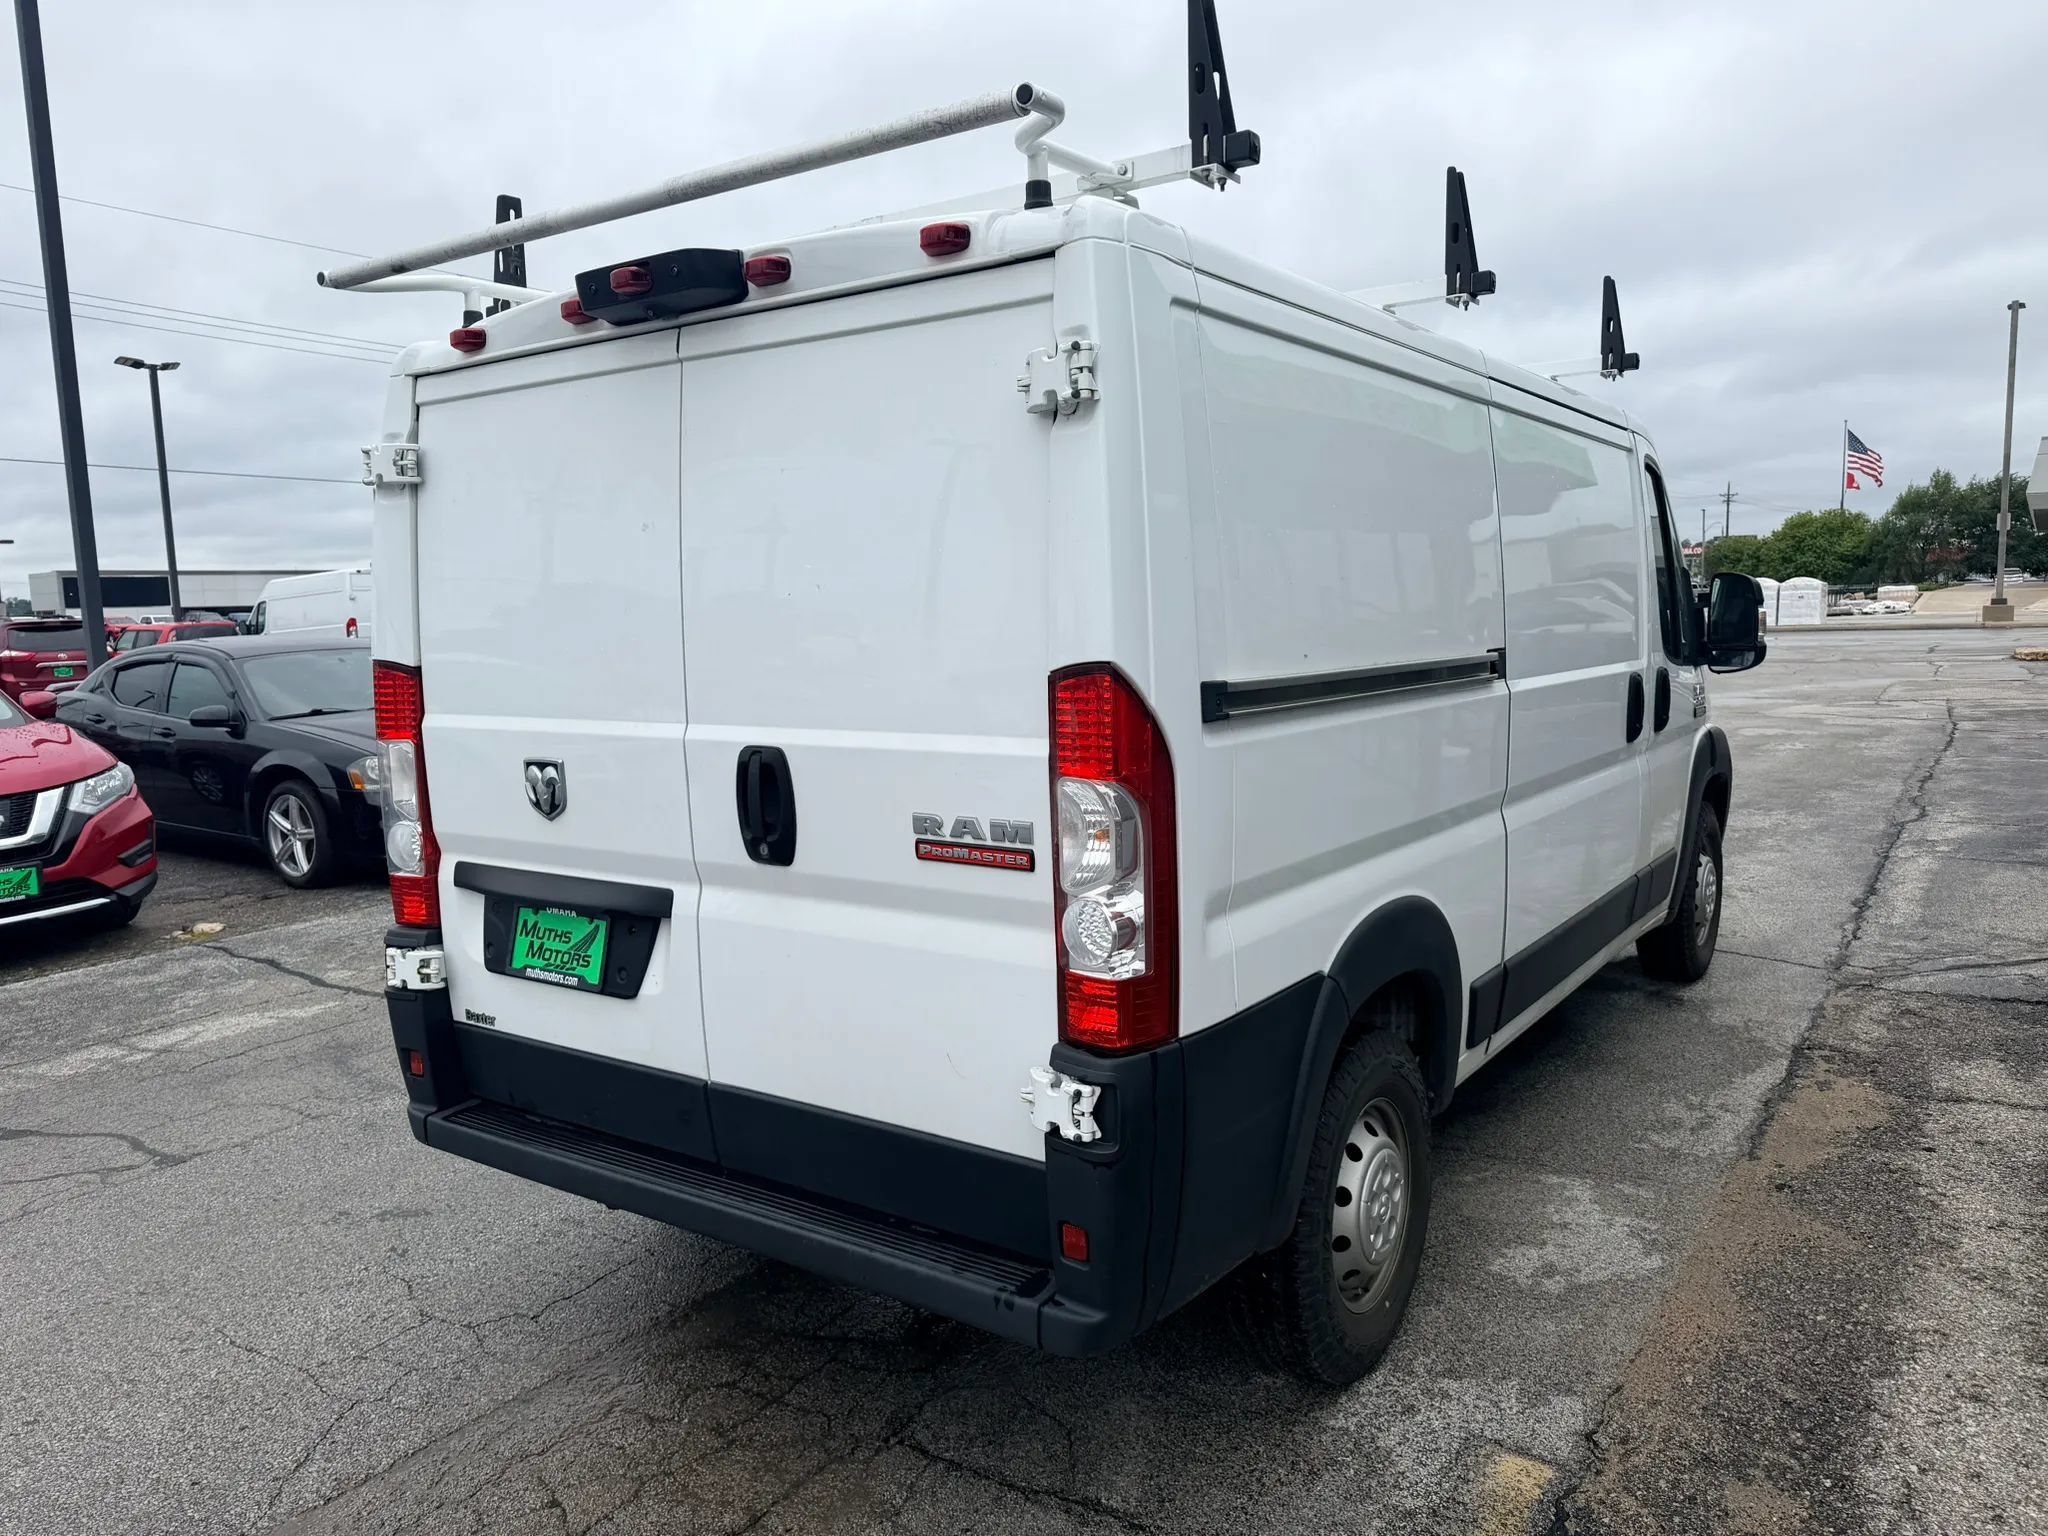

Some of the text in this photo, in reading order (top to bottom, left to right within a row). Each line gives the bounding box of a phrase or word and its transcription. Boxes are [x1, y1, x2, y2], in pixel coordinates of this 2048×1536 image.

[912, 812, 1034, 845] RAM
[919, 844, 1029, 866] PROMASTER
[519, 918, 574, 944] MUTHS
[525, 939, 592, 969] MOTORS
[525, 967, 579, 987] muthsmotors.com
